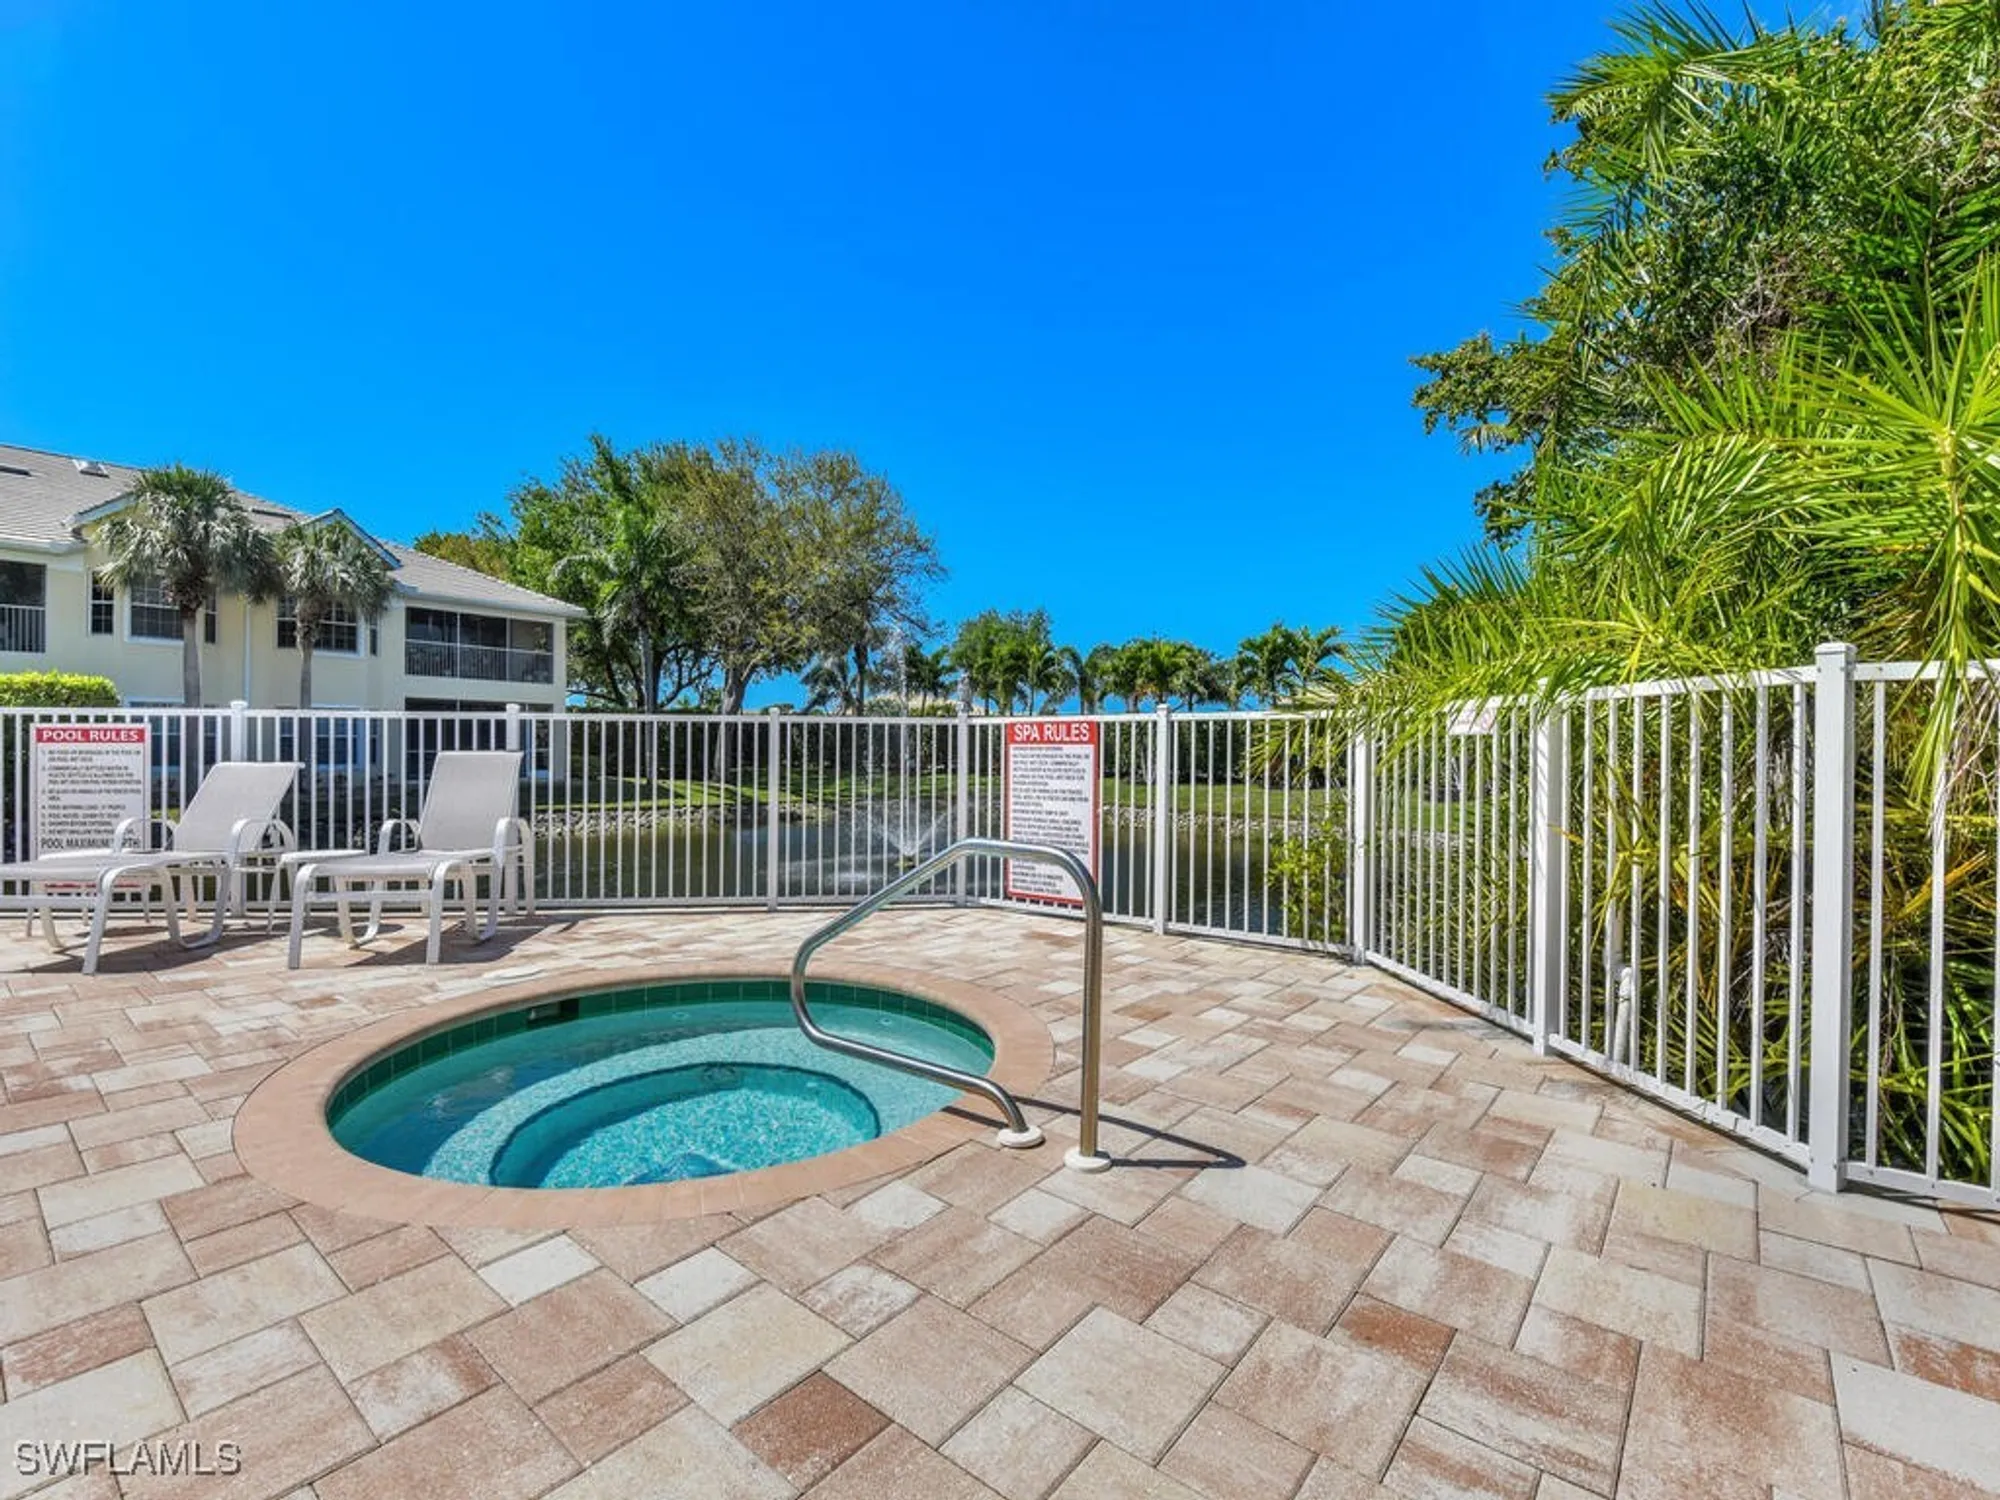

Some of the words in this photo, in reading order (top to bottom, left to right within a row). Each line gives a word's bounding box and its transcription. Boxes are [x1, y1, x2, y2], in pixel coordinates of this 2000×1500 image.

[42, 730, 85, 741] POOL
[89, 730, 139, 741] RULES
[1014, 723, 1040, 742] SPA
[1043, 722, 1089, 742] RULES
[41, 837, 65, 849] POOL
